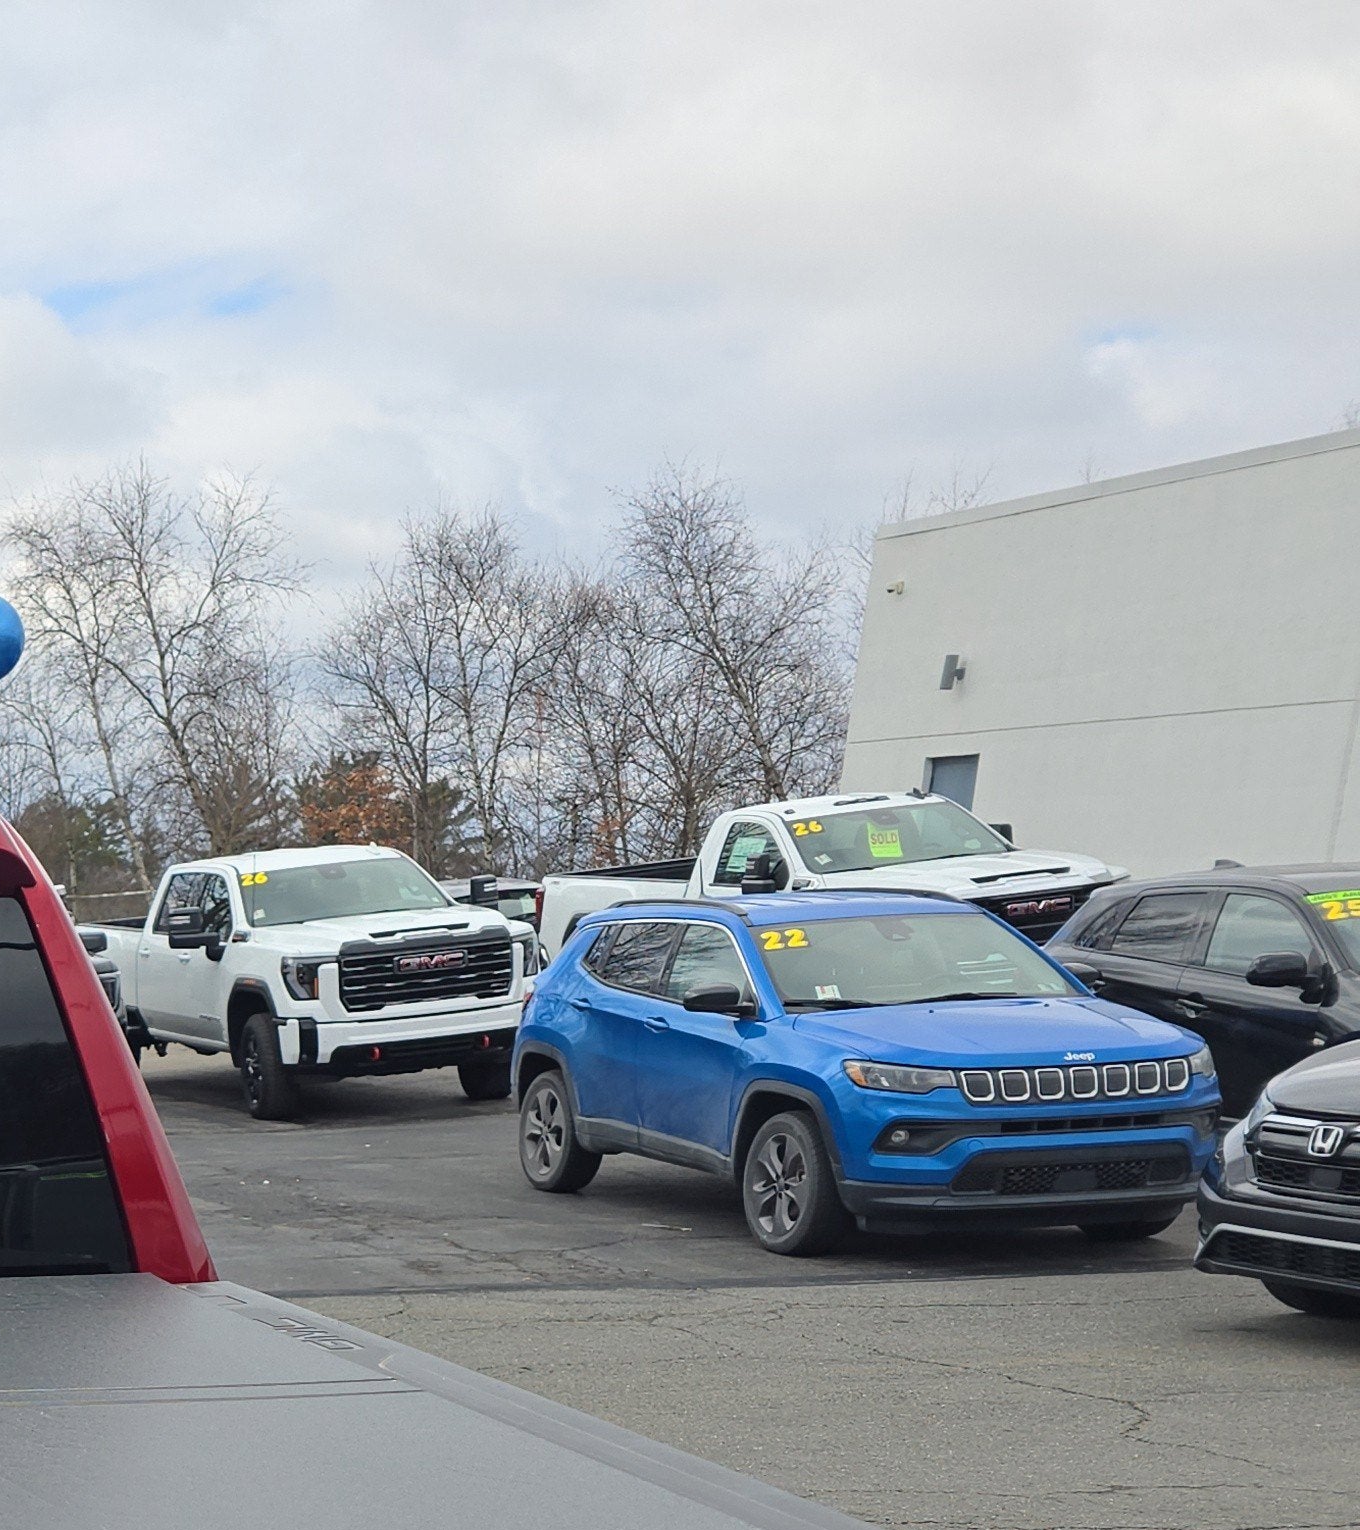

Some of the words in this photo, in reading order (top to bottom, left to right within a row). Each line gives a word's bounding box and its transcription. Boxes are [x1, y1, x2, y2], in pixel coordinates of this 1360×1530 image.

[792, 821, 823, 836] 26
[871, 831, 898, 845] SOLD
[241, 872, 268, 886] 26
[1007, 897, 1071, 916] GMC
[760, 929, 809, 950] 22
[400, 952, 464, 971] GMC
[1063, 1052, 1096, 1061] Jeep
